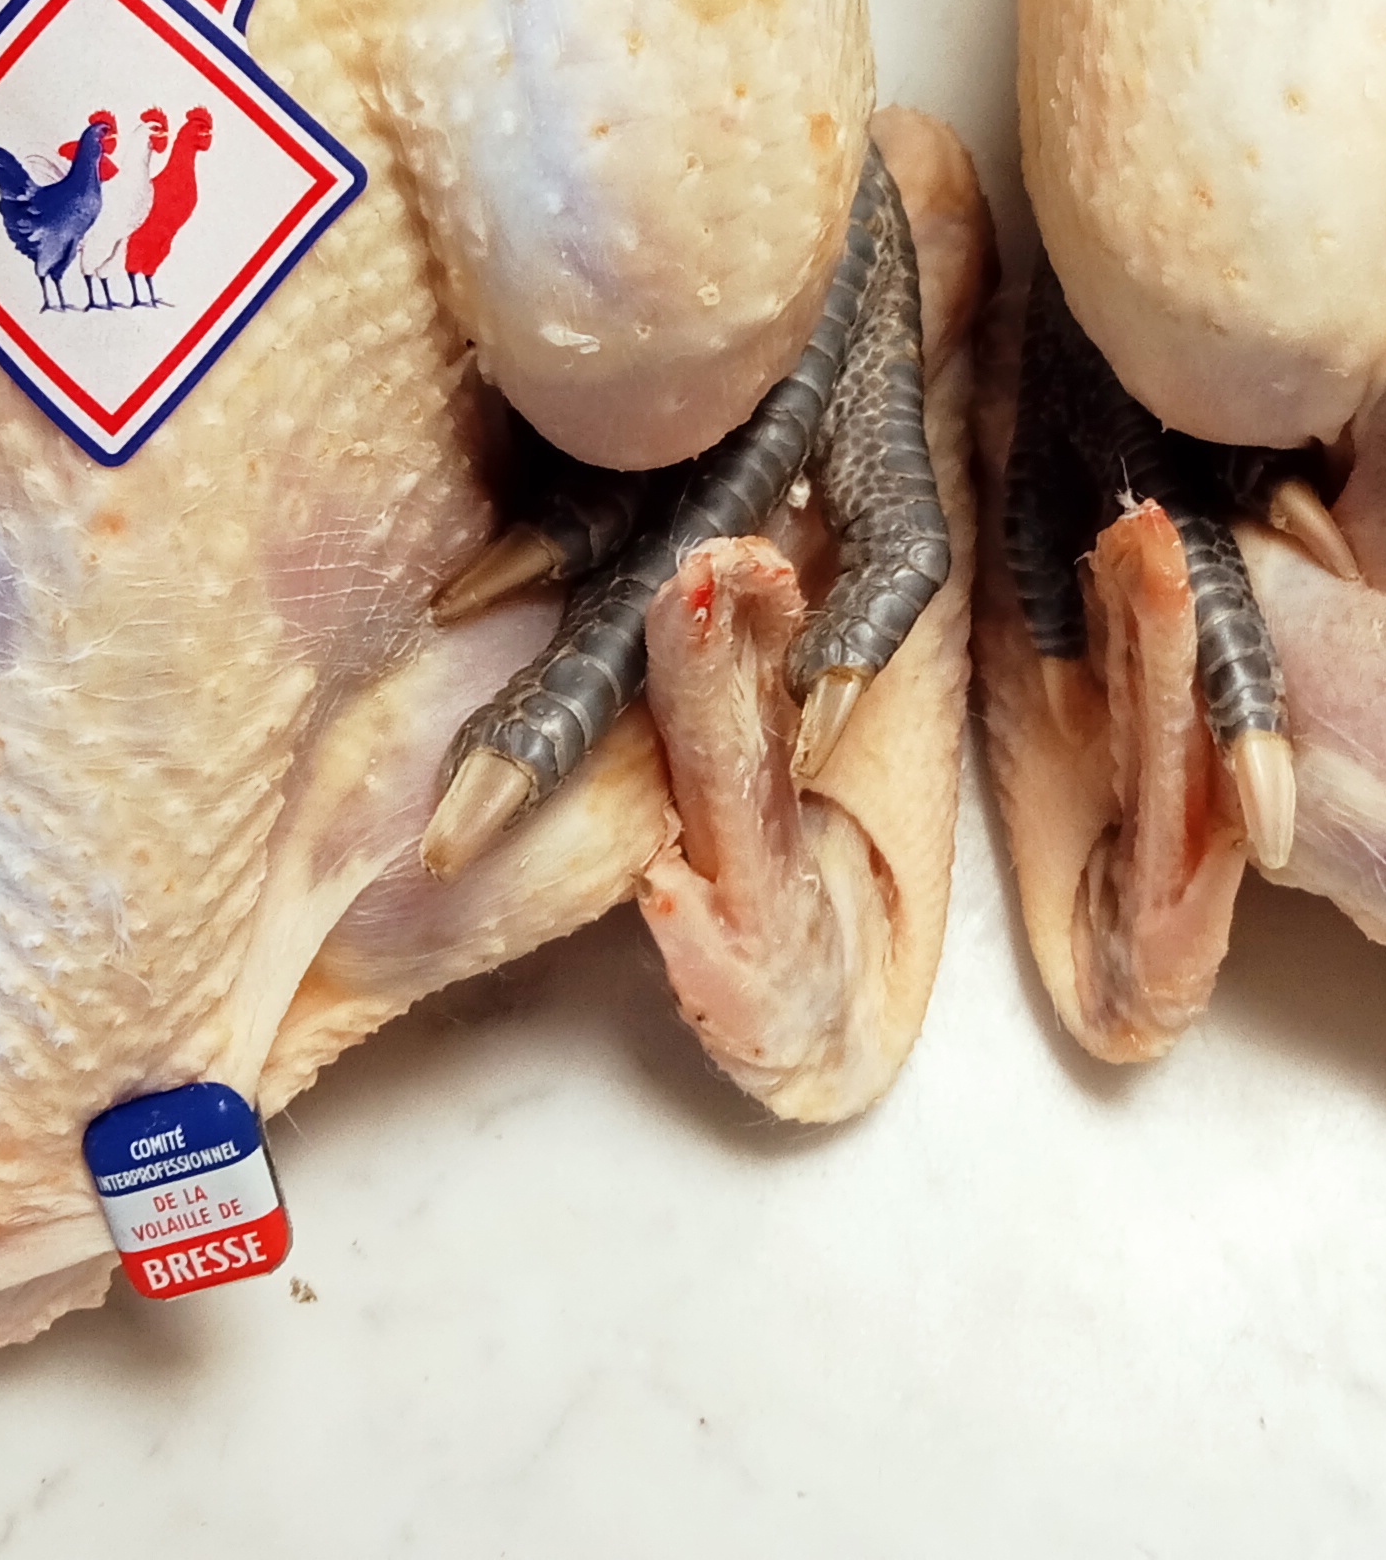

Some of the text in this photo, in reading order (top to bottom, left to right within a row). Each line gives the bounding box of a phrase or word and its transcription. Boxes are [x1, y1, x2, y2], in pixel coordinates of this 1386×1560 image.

[129, 1123, 187, 1161] COMITÉ
[95, 1140, 242, 1192] INTERPROFESSIONNEL
[130, 1198, 244, 1242] VOLAILLE DE
[152, 1185, 209, 1214] DE LA
[141, 1231, 268, 1291] BRESSE
